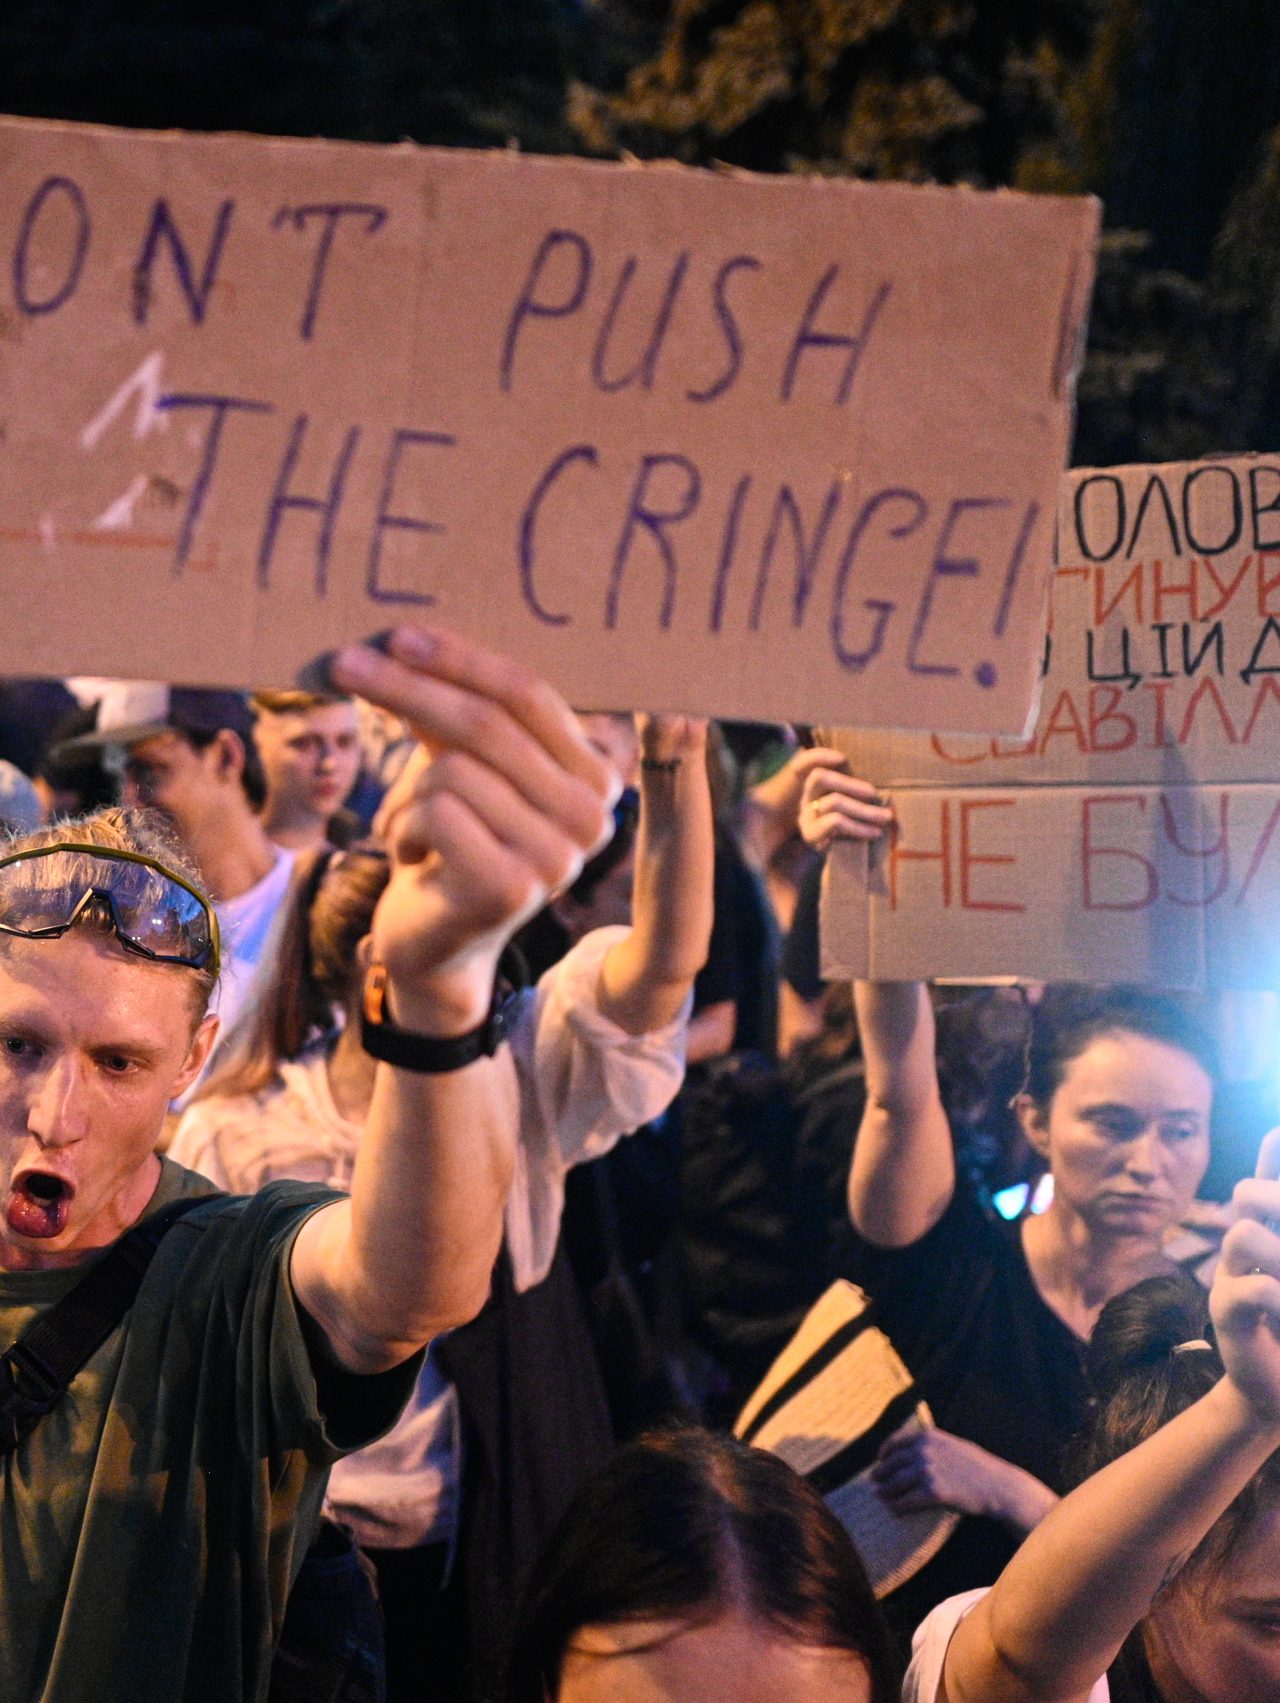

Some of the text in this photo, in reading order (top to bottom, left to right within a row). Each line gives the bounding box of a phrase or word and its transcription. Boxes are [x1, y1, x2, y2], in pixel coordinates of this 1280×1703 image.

[499, 228, 893, 405] PUSH
[155, 394, 1040, 690] THE CRINGE!
[1053, 465, 1280, 565] ОЛОВ
[1086, 618, 1224, 690] ЦІЙ
[888, 797, 1027, 914] НЕ
